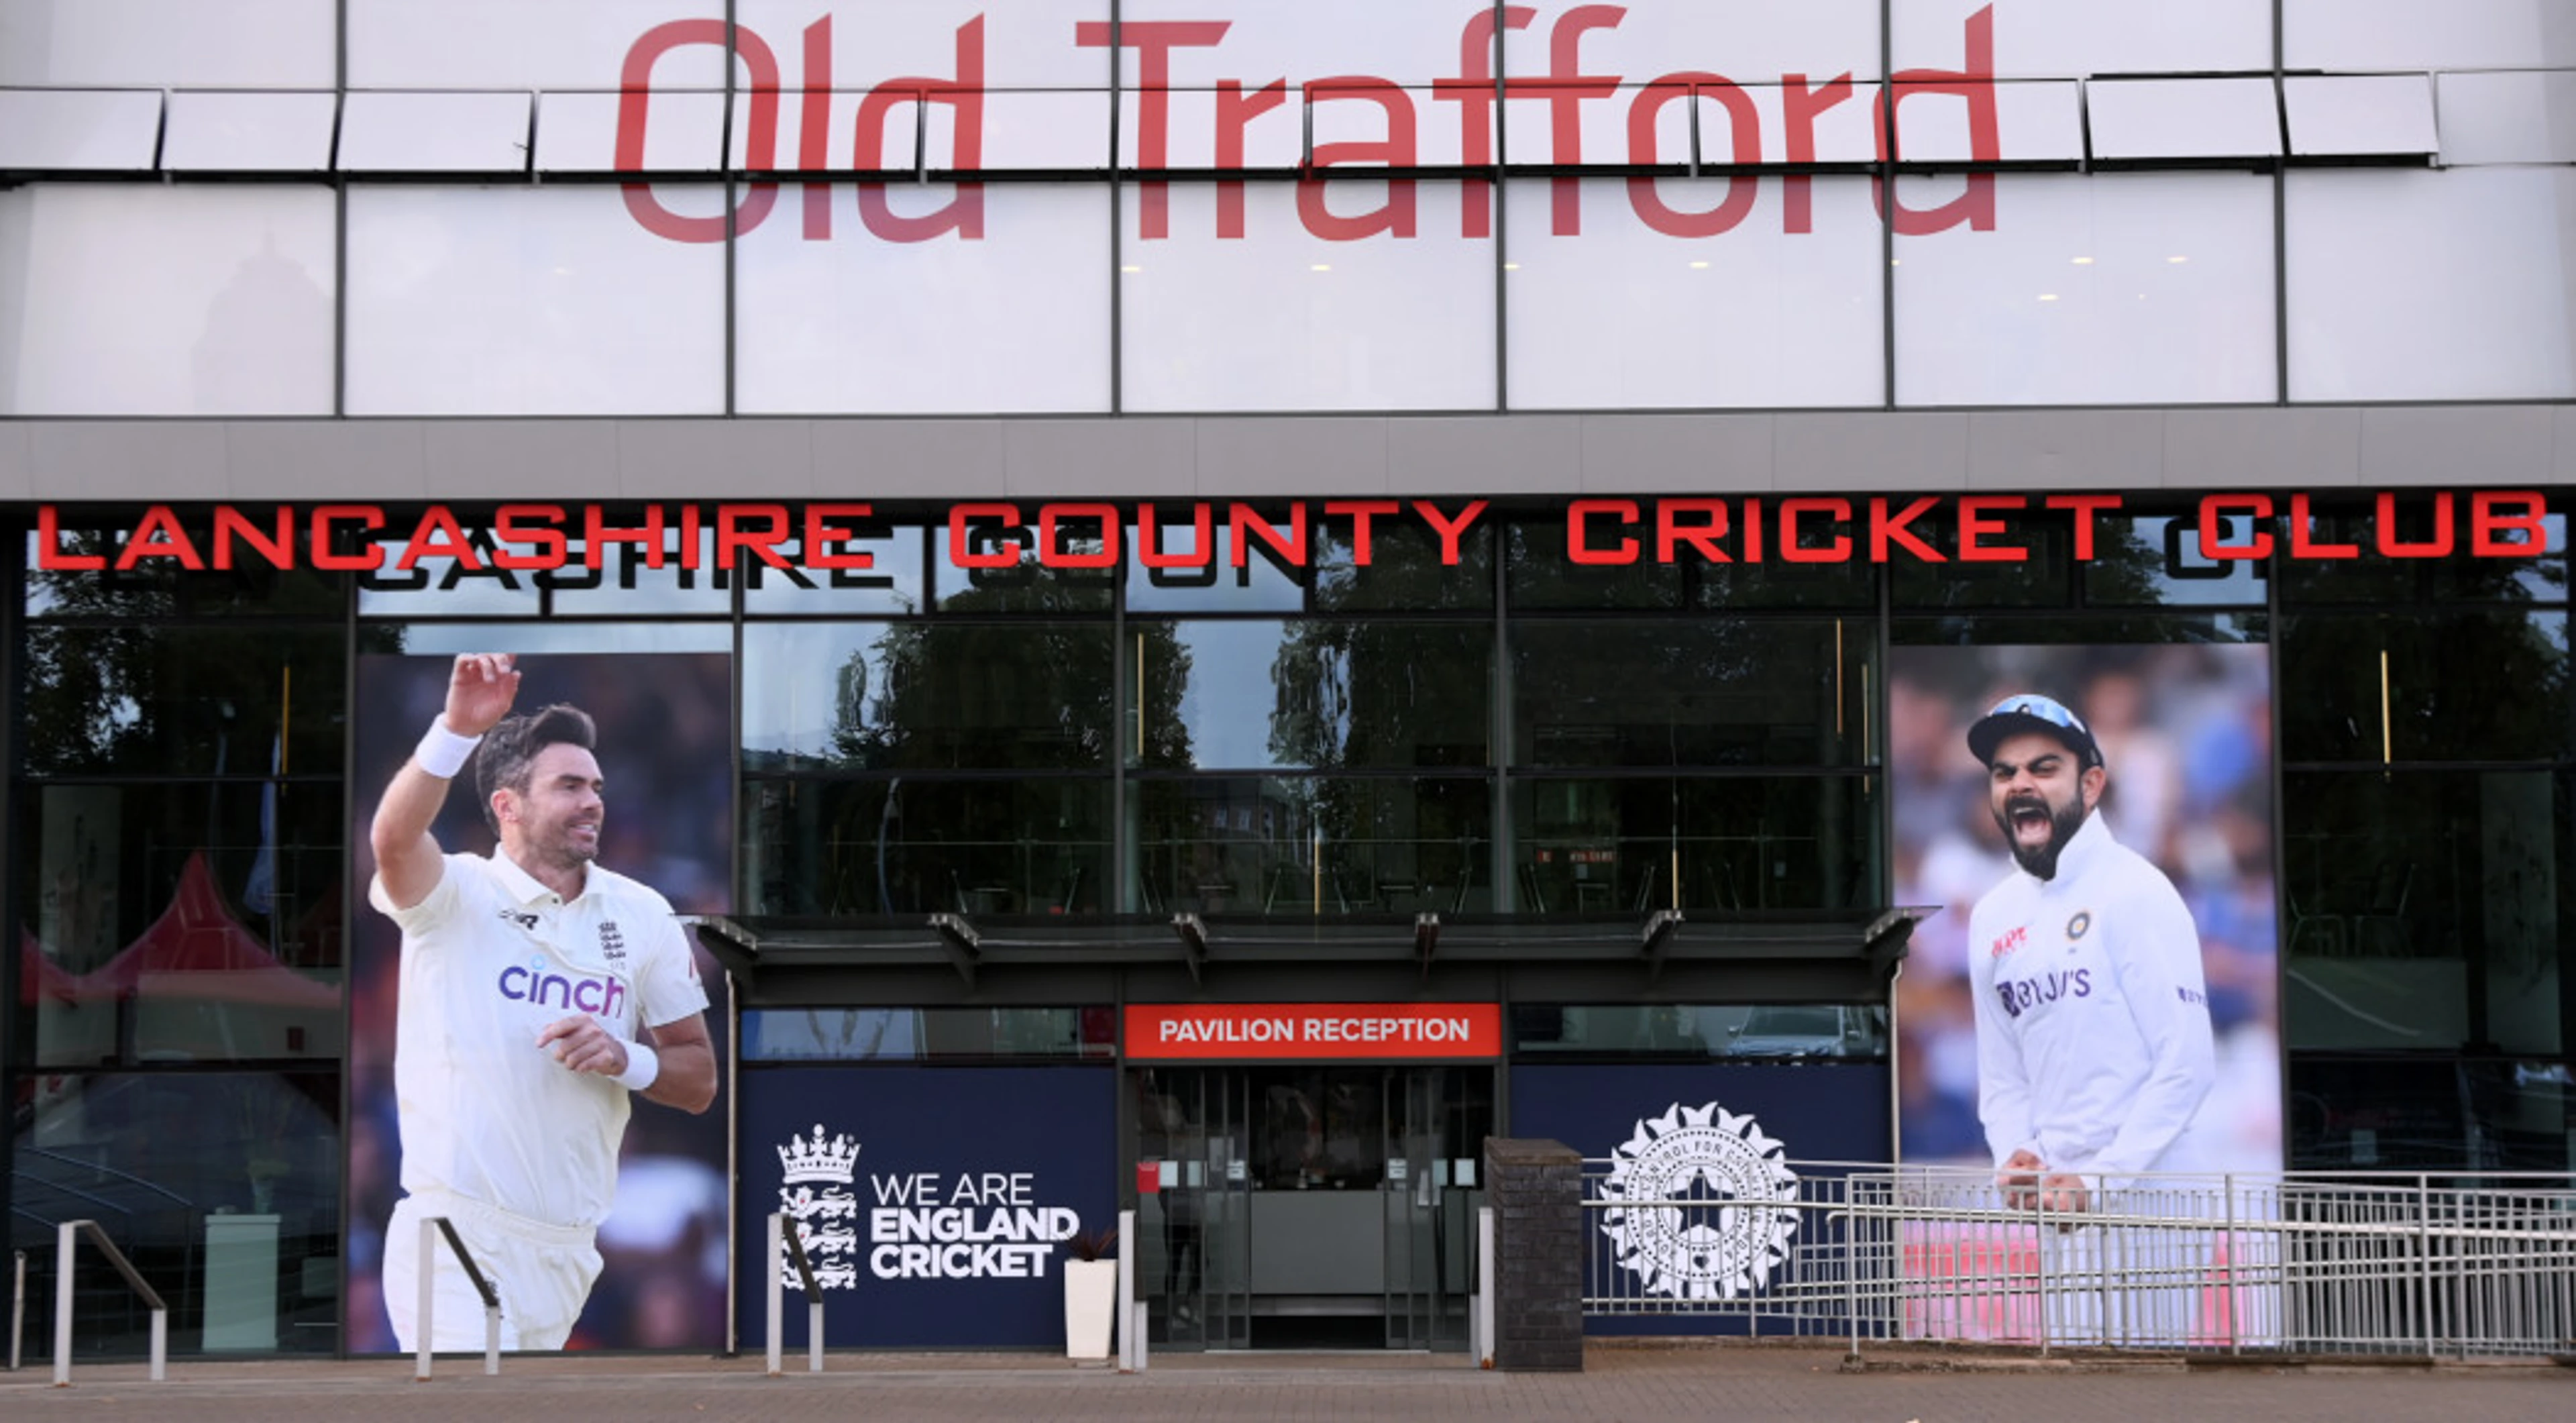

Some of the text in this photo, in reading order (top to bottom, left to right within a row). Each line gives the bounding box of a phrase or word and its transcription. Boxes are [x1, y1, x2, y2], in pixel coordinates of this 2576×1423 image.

[614, 3, 2000, 243] Old Trafford
[39, 491, 2546, 570] LANCASHIRE COUNTY CRICKET CLUB
[498, 954, 625, 1019] cinch
[1159, 1018, 1470, 1042] PAVILION RECEPTION
[871, 1173, 1034, 1206] WE ARE
[871, 1207, 1080, 1243] ENGLAND
[871, 1243, 1053, 1279] CRICKET
